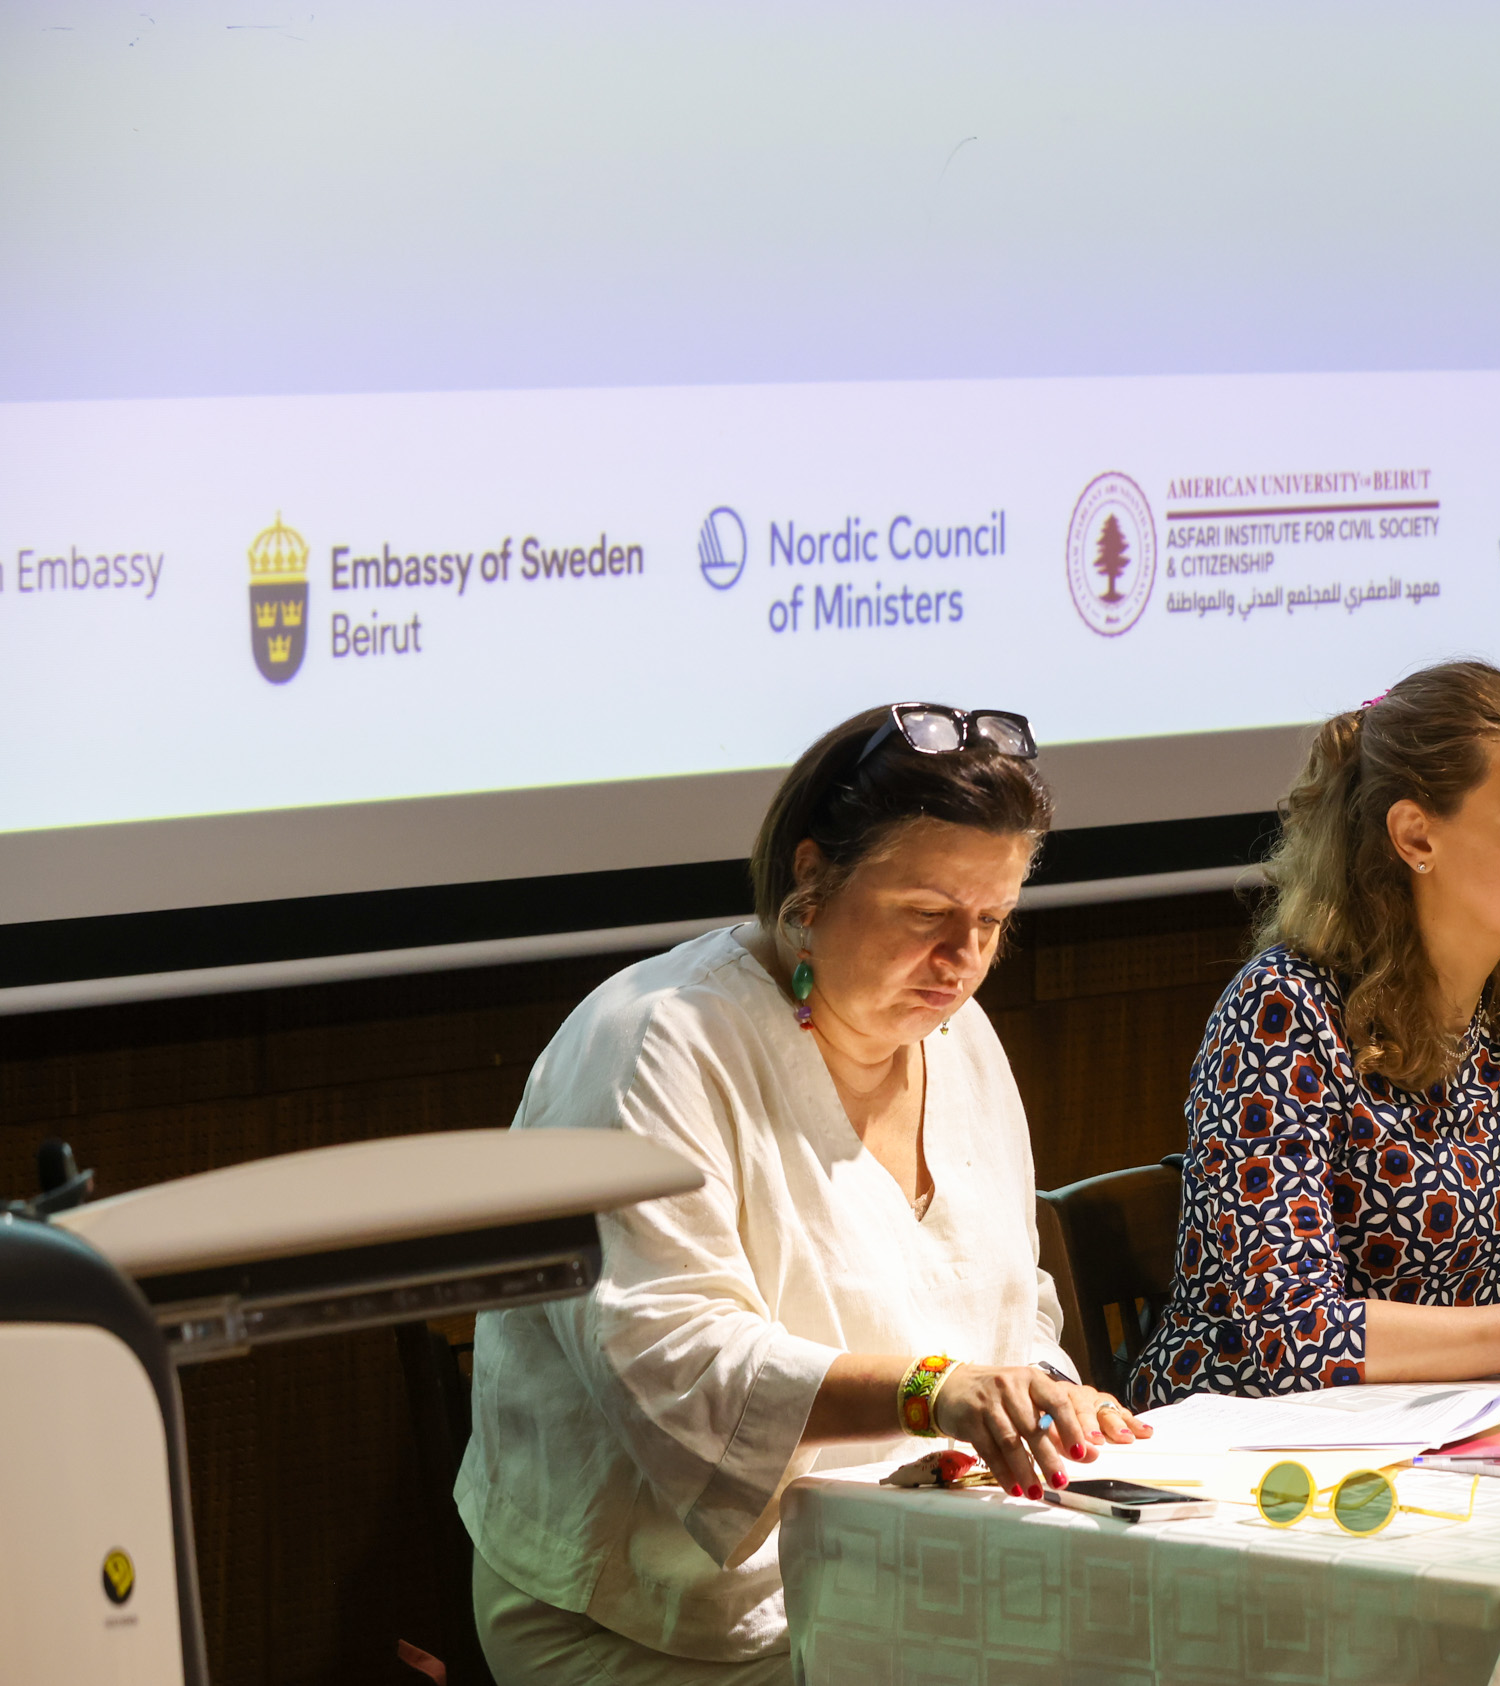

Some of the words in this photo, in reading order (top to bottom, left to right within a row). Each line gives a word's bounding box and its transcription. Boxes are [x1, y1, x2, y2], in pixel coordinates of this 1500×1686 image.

[1167, 475, 1257, 499] AMERICAN
[1261, 472, 1361, 496] UNIVERSITY
[1373, 469, 1431, 491] BEIRUT
[770, 516, 878, 567] Nordic
[888, 509, 1005, 561] Council
[1167, 526, 1220, 549] ASFARI
[1225, 522, 1300, 546] INSTITUTE
[1305, 520, 1335, 542] FOR
[1339, 518, 1375, 540] CIVIL
[1379, 516, 1439, 539] SOCIETY
[18, 545, 164, 600] Embassy
[331, 542, 473, 597] Embassy
[480, 537, 512, 582] of
[521, 532, 644, 581] Sweden
[1167, 556, 1176, 578] &
[1182, 552, 1274, 577] CITIZENSHIP
[769, 584, 804, 633] of
[814, 580, 963, 630] Ministers
[1166, 589, 1235, 618] والمواطنة
[1238, 586, 1283, 622] المدني
[1286, 582, 1341, 616] للمجتمع
[1405, 580, 1440, 605] معهد
[332, 610, 422, 658] Beirut
